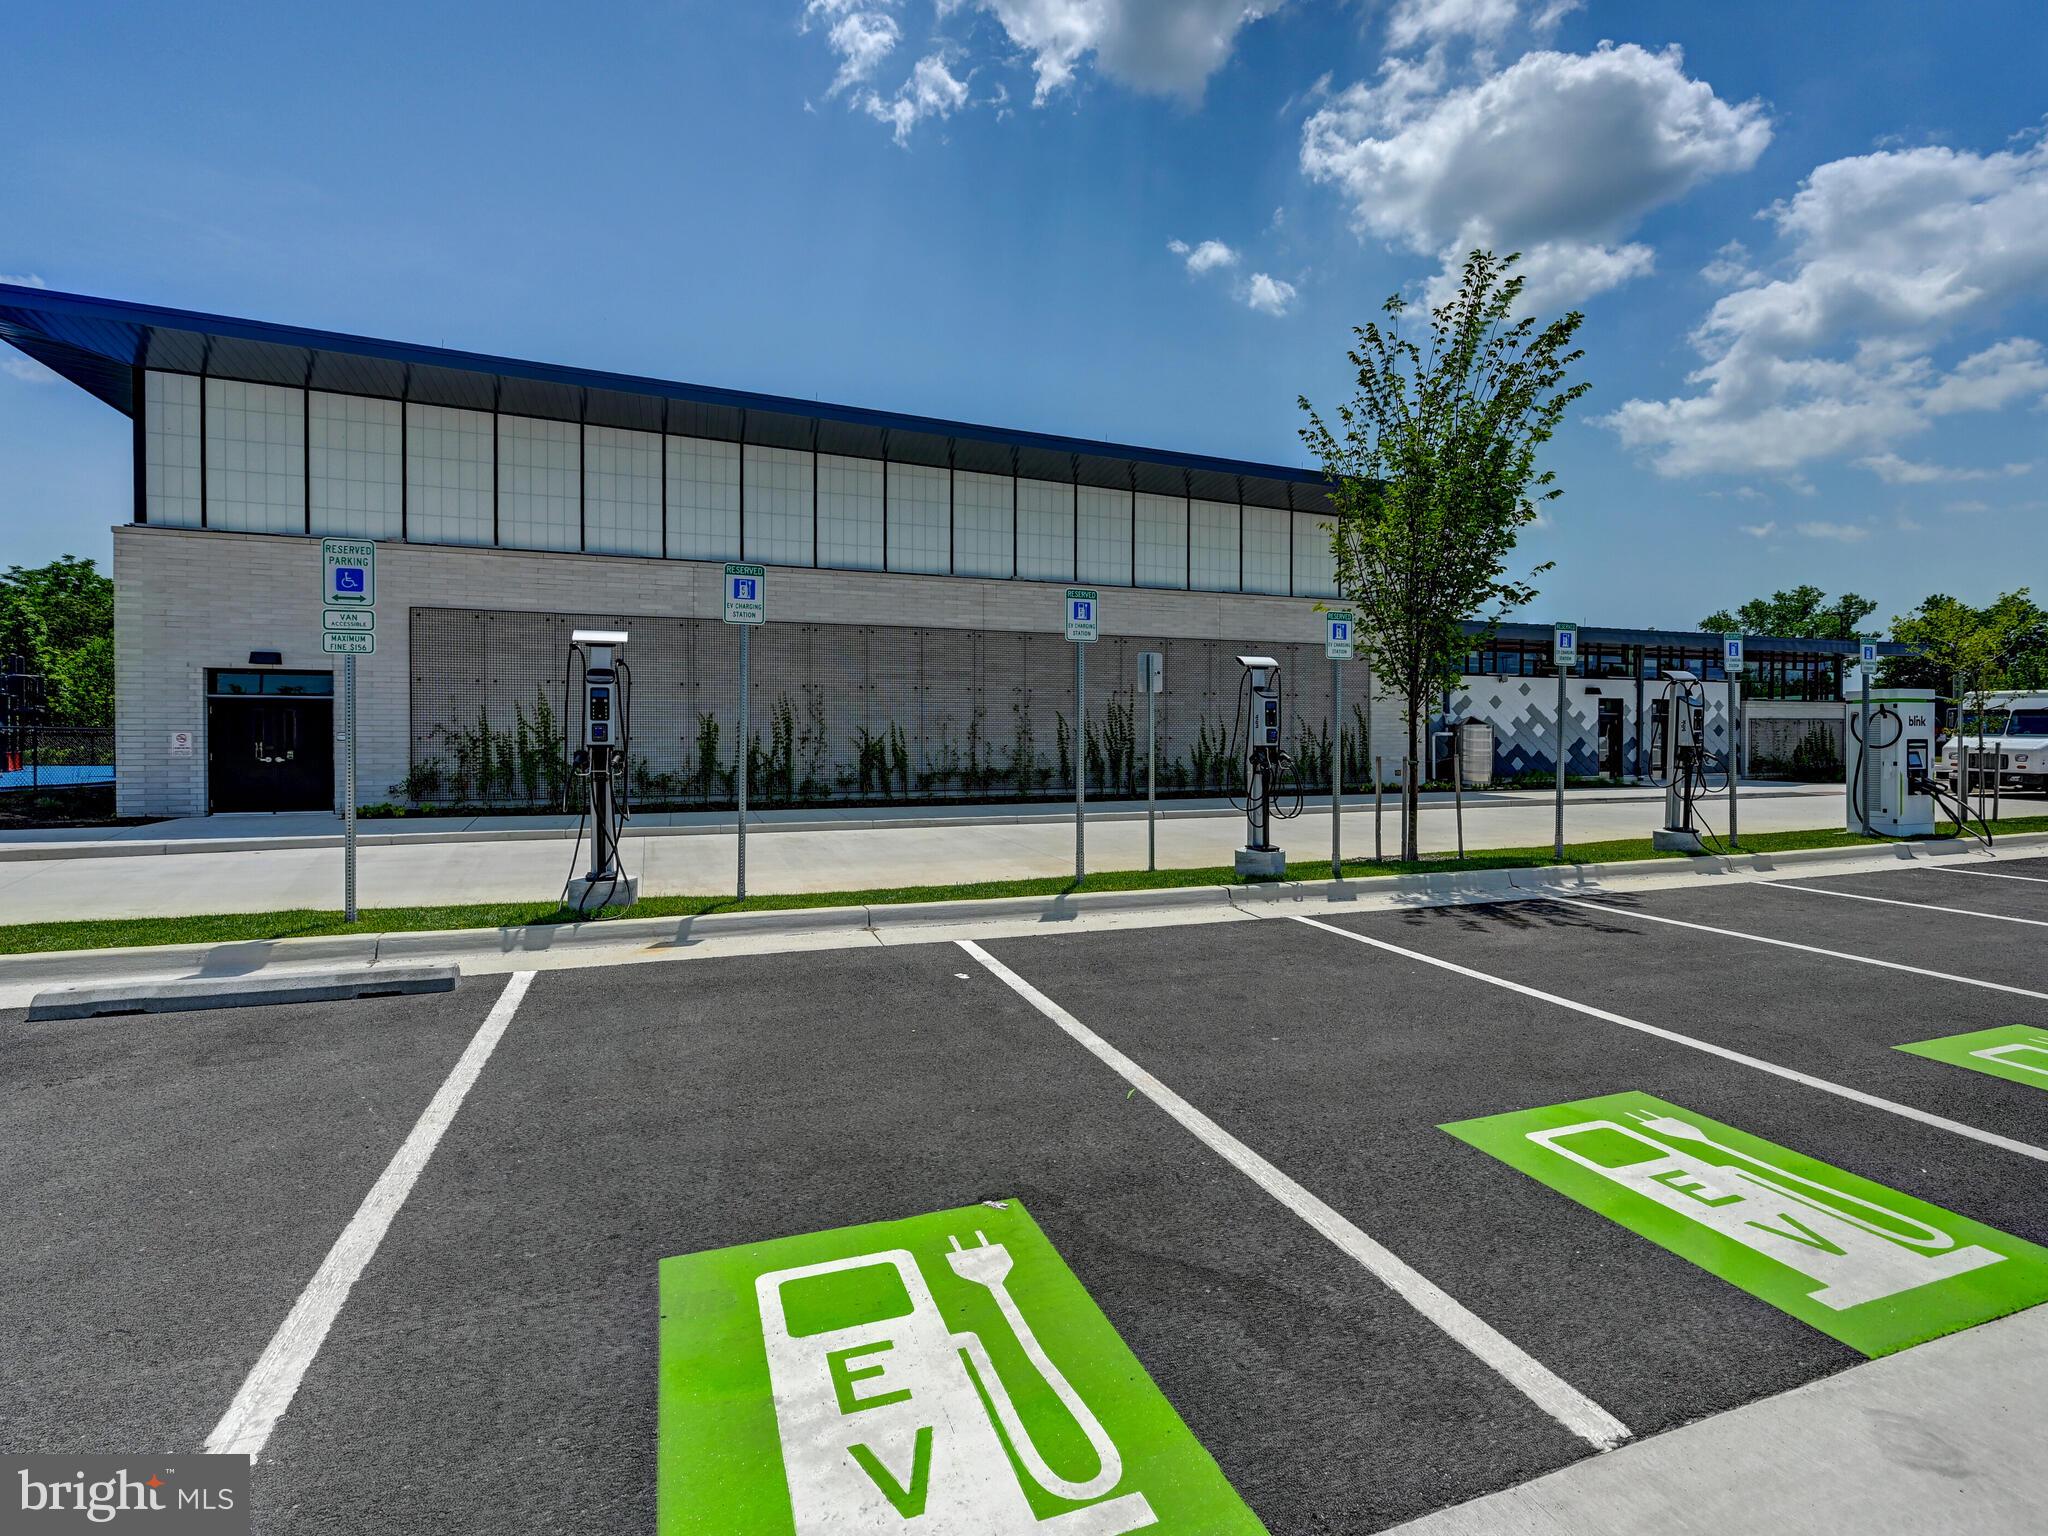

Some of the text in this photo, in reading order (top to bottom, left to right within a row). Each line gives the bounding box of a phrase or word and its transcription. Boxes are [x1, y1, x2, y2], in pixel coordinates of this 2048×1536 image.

[325, 544, 372, 555] RESERVED
[329, 556, 369, 567] PARKING
[726, 565, 763, 576] RESERVED
[1067, 590, 1096, 599] RESERVED
[330, 643, 367, 651] FINE $156
[1908, 715, 1926, 727] blink
